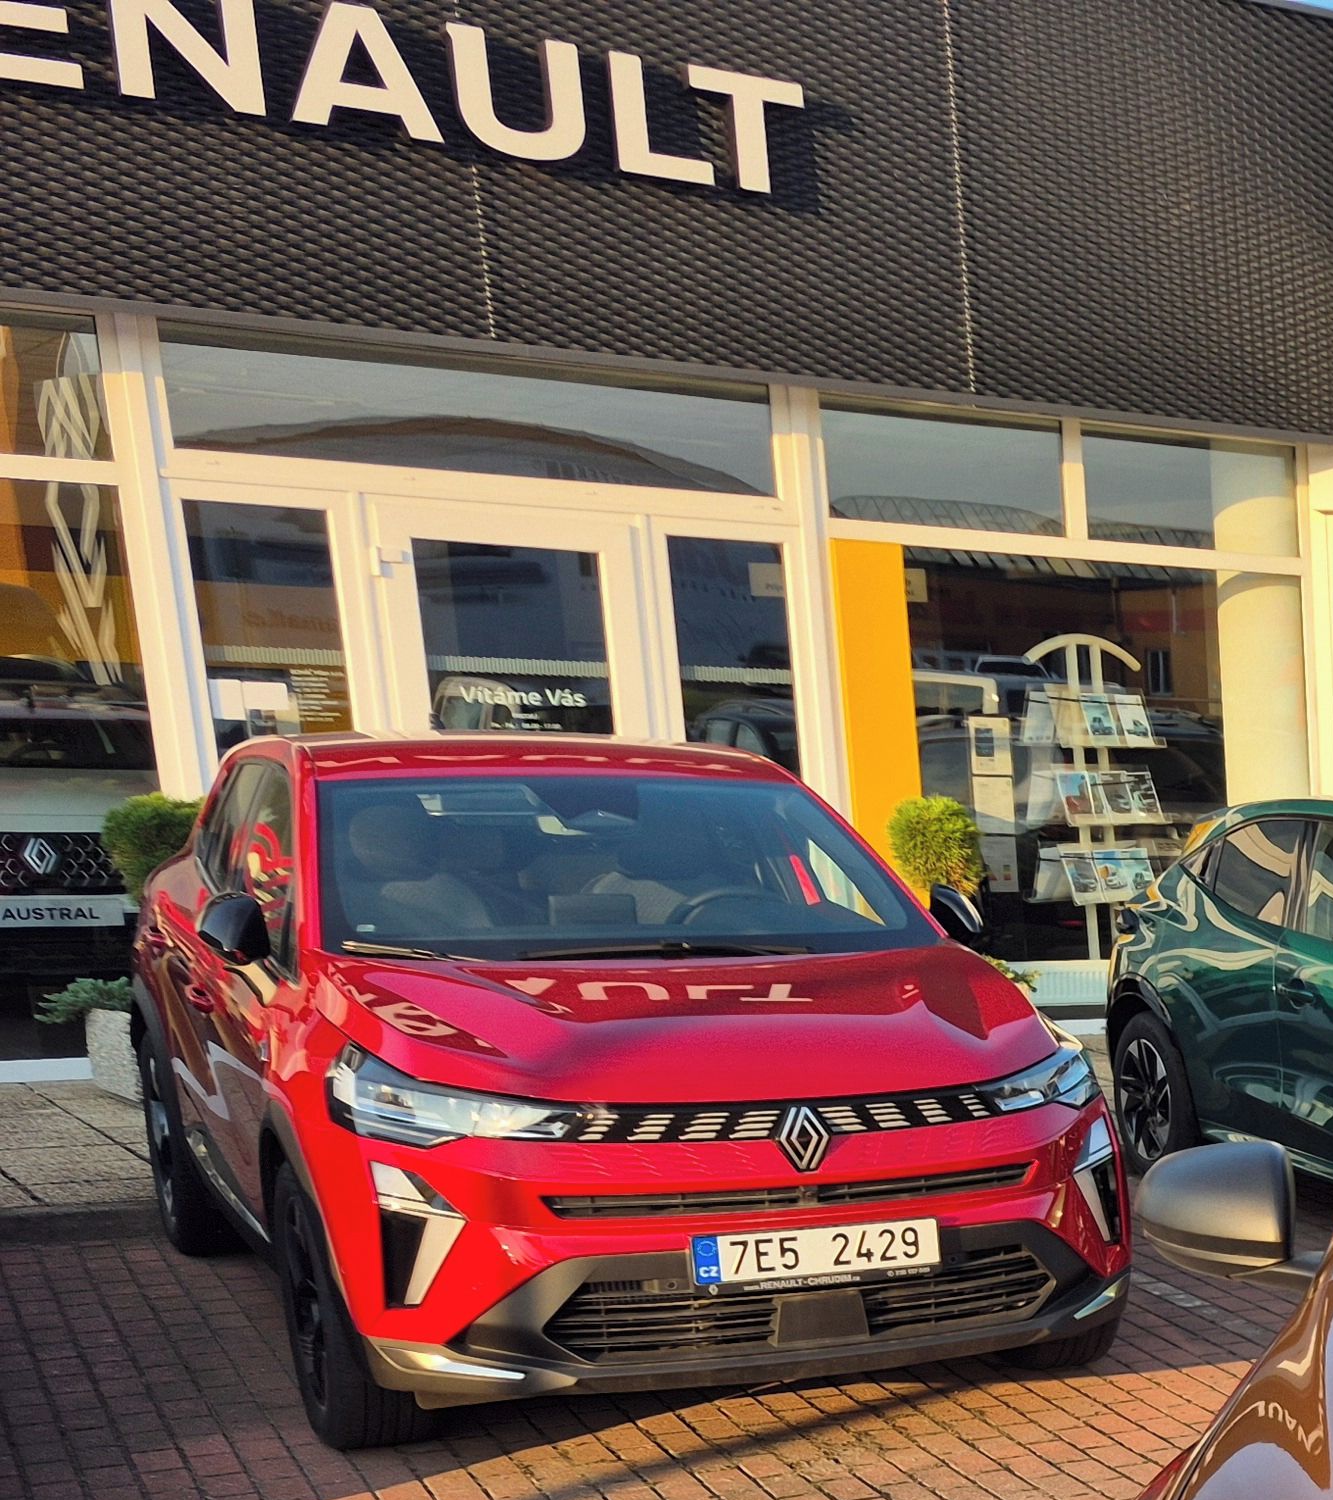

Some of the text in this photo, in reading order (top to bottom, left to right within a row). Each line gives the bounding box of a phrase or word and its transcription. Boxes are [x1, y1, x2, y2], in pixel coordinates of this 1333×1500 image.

[2, 907, 101, 921] AUSTRAL
[729, 1226, 920, 1274] 7E5 2429
[699, 1265, 719, 1279] CZ
